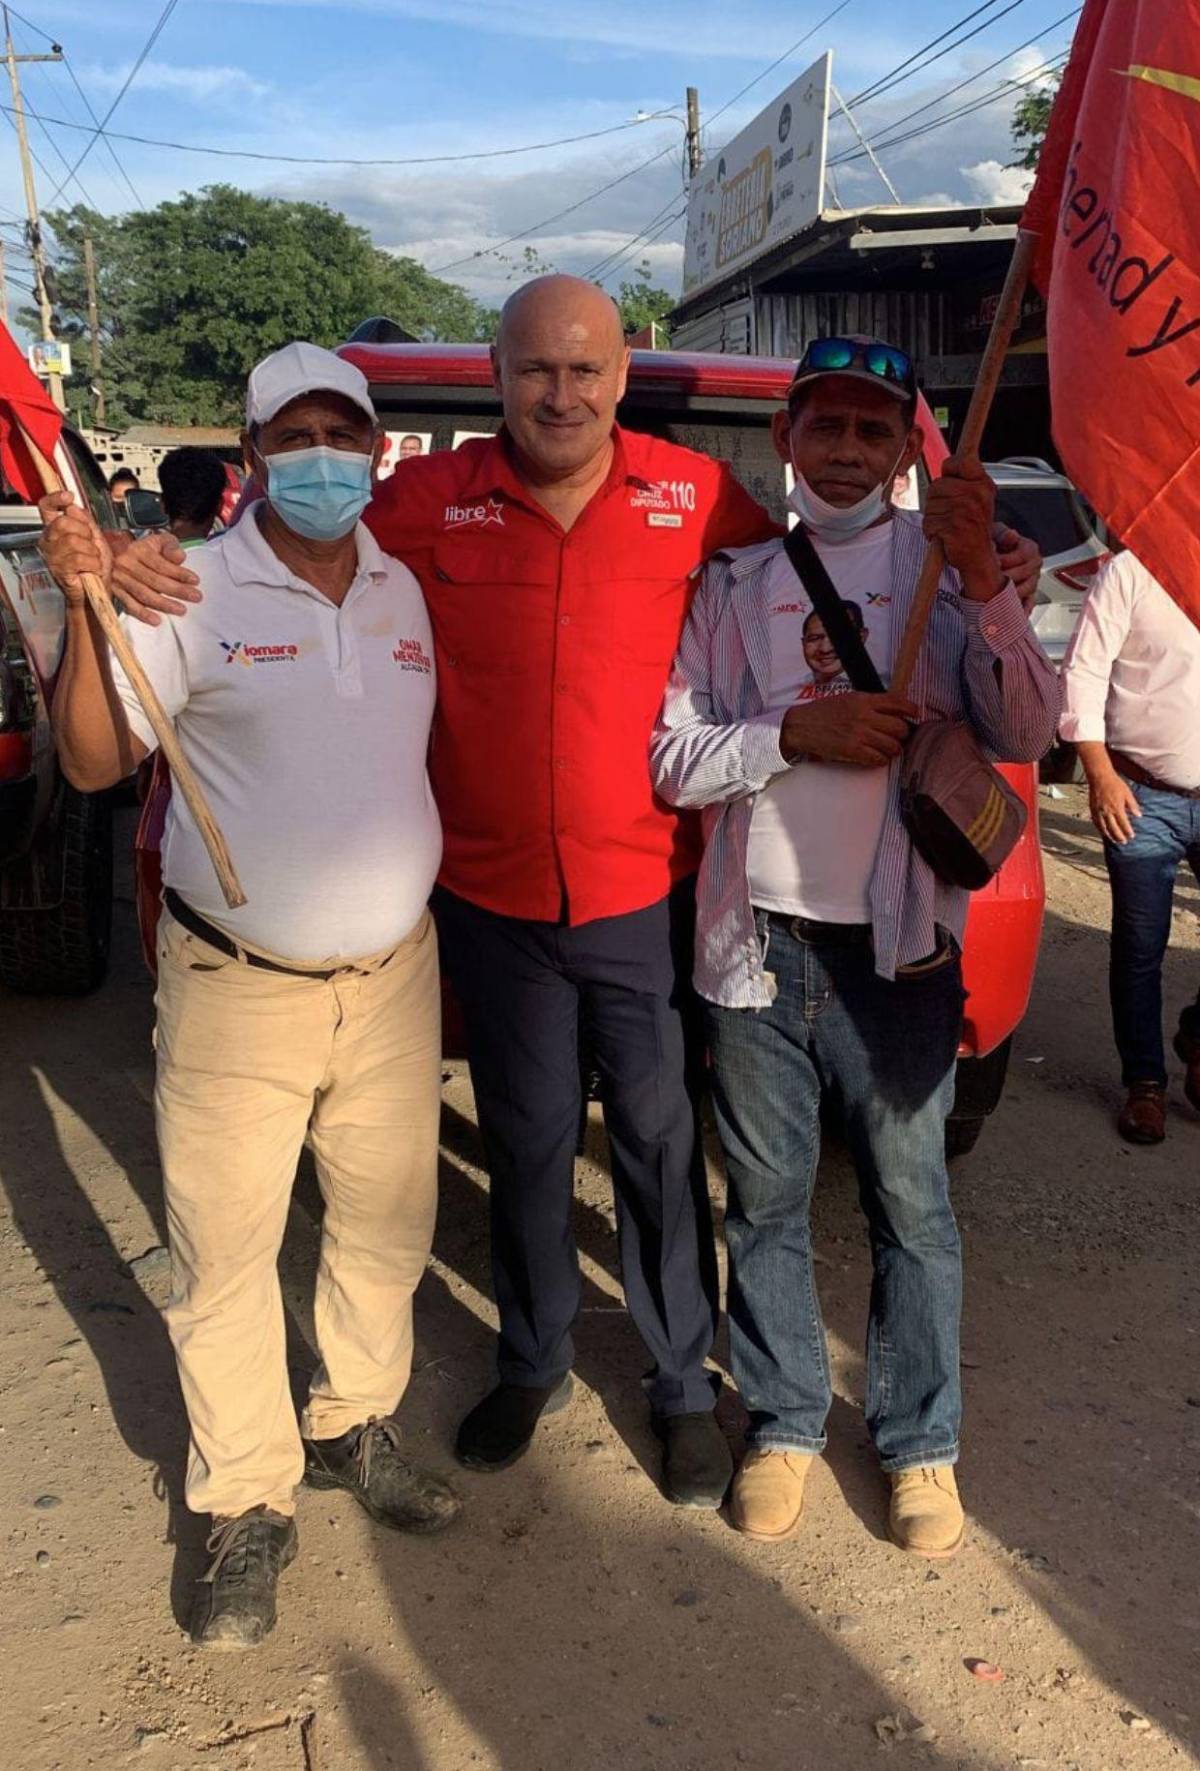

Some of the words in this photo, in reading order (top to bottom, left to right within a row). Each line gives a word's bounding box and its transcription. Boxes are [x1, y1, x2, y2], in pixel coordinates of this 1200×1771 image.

[630, 497, 671, 509] DIPUTADO
[670, 481, 696, 511] 110
[445, 506, 487, 521] libre
